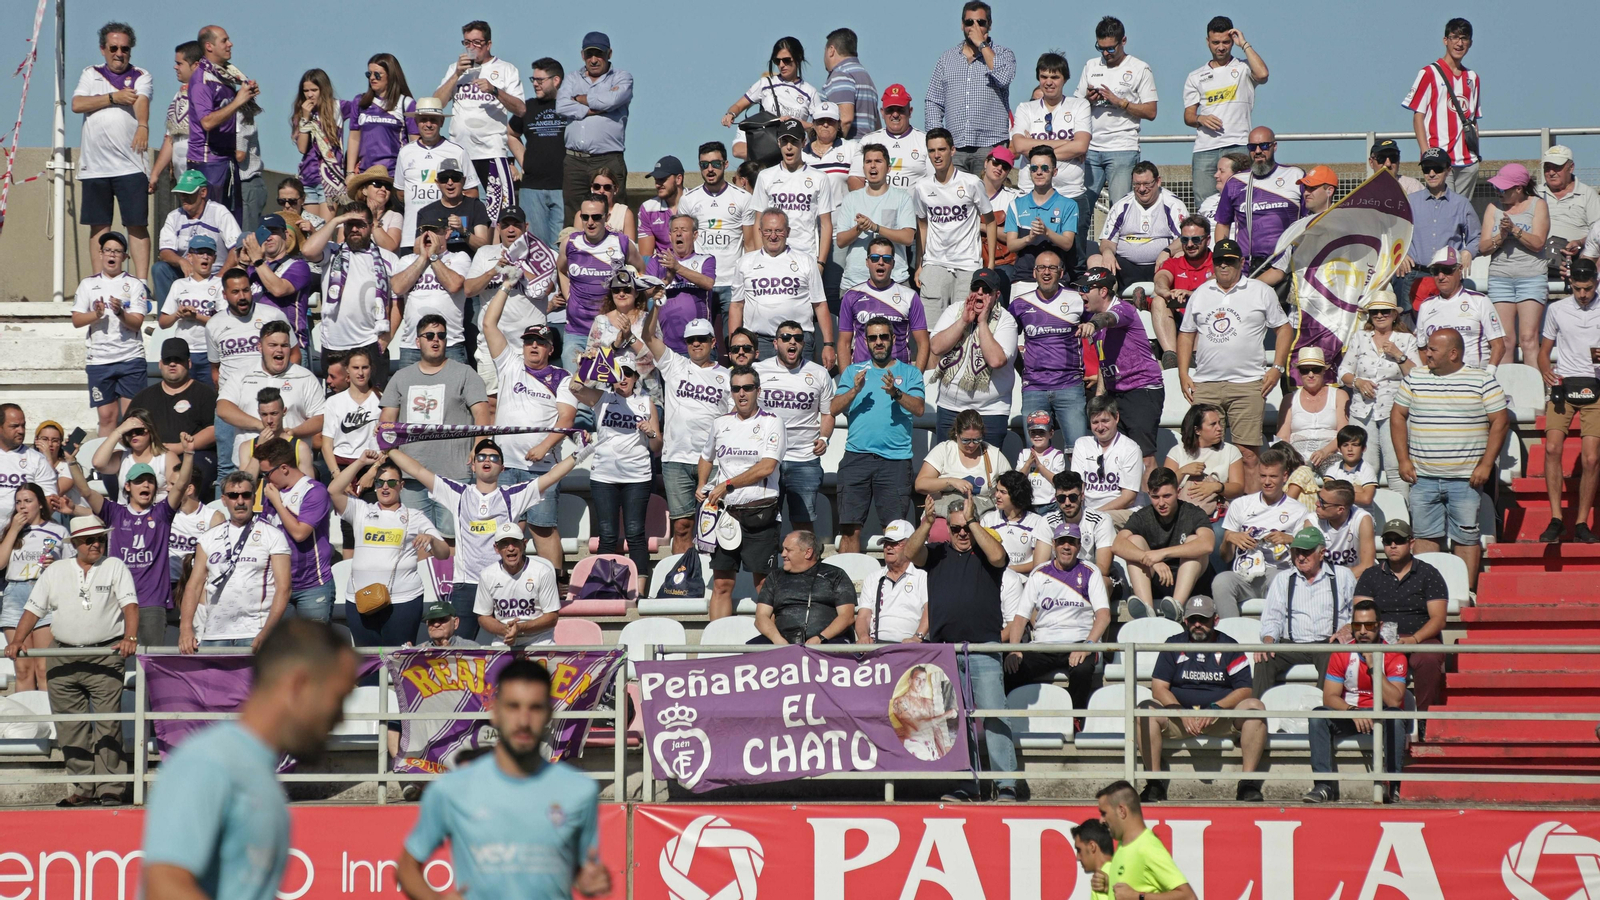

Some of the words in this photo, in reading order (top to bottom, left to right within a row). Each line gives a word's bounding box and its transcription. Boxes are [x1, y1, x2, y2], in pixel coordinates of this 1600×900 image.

[455, 93, 496, 102] SUMAMOS
[366, 116, 397, 125] Avanza
[886, 171, 909, 187] aén
[771, 193, 812, 204] TODOS
[928, 204, 968, 216] TODOS
[1253, 202, 1288, 212] Avanza
[701, 231, 730, 246] Jaén
[581, 268, 612, 276] Avanz
[751, 277, 801, 289] TODOS
[752, 287, 798, 296] SUMAMOS
[870, 312, 903, 322] Anza
[1037, 326, 1072, 335] Avanza
[220, 335, 261, 350] TODO
[221, 345, 261, 358] SUMAM
[678, 379, 723, 399] TODOS
[1567, 391, 1595, 399] ellesse
[676, 390, 720, 406] SUMAMOS
[763, 389, 814, 402] TODOS
[763, 400, 812, 410] SUMAMOS
[345, 411, 371, 425] NIKE
[604, 409, 648, 423] TODO
[602, 419, 638, 430] SUMAM
[725, 446, 758, 456] Avanza
[0, 473, 27, 485] DOS
[364, 532, 390, 542] GEA
[390, 533, 402, 542] 21
[121, 547, 153, 563] Jaén
[1324, 547, 1357, 561] ODOS
[19, 563, 40, 579] 47
[494, 598, 535, 610] TODOS
[1054, 599, 1084, 608] Avanza
[402, 658, 487, 699] REAL
[641, 669, 730, 701] Peña
[734, 655, 811, 693] Real
[814, 657, 891, 688] Jaén
[1181, 669, 1213, 682] ALGECIRAS
[1213, 671, 1225, 681] C.F.
[782, 693, 826, 728] EL
[671, 739, 690, 750] jaén
[743, 730, 878, 776] CHATO
[806, 815, 1447, 900] PADLLA
